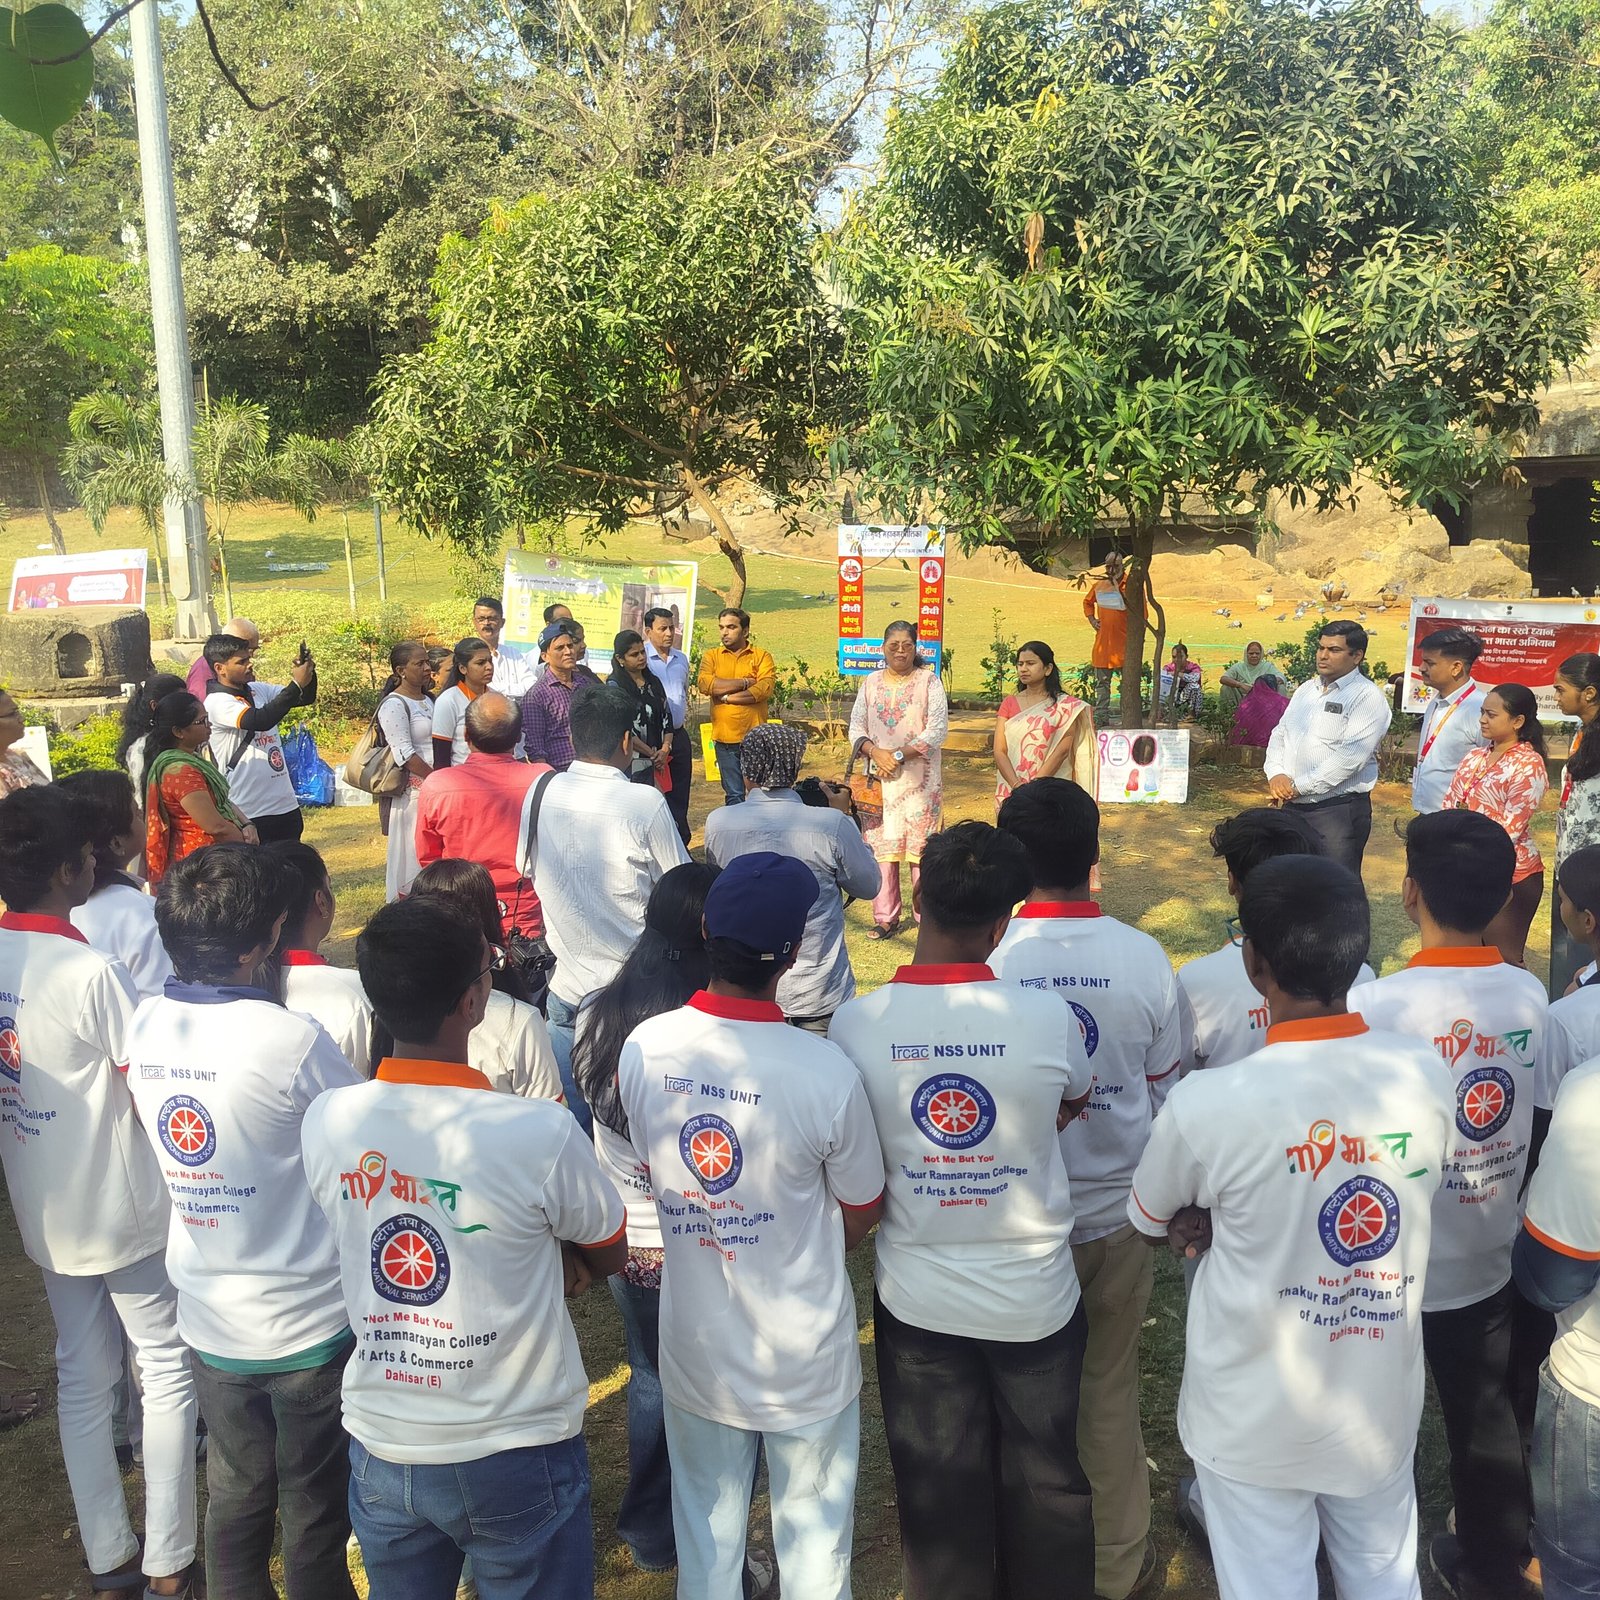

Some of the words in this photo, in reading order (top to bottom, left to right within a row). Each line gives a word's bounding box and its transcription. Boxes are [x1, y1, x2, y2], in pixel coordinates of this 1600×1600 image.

[1053, 976, 1077, 988] NSS
[1080, 976, 1110, 989] UNIT
[934, 1045, 964, 1057] NSS
[967, 1044, 1006, 1057] UNIT
[171, 1068, 191, 1079] NSS
[194, 1070, 217, 1082] UNIT
[701, 1083, 725, 1099] NSS
[730, 1089, 761, 1106] UNIT
[1094, 1084, 1123, 1095] College
[919, 1116, 944, 1141] NATIONAL
[945, 1134, 973, 1145] SERVICE
[972, 1115, 990, 1139] SCHEME
[162, 1133, 183, 1160] NATIONAL
[1470, 1148, 1480, 1156] Me
[1481, 1144, 1494, 1155] But
[1496, 1140, 1511, 1149] You
[923, 1155, 940, 1163] Not
[943, 1155, 956, 1163] Me
[958, 1155, 975, 1163] But
[977, 1154, 994, 1163] You
[1453, 1155, 1505, 1172] Ramnarayan
[166, 1170, 178, 1178] Not
[180, 1171, 190, 1180] Me
[192, 1171, 206, 1180] But
[208, 1172, 224, 1180] You
[929, 1169, 990, 1182] Ramnarayan
[993, 1165, 1028, 1179] College
[171, 1183, 221, 1198] Ramnarayan
[634, 1180, 651, 1193] Arts
[913, 1185, 923, 1195] of
[926, 1186, 946, 1197] Arts
[950, 1186, 957, 1196] &
[959, 1182, 1009, 1196] Commerce
[1446, 1180, 1469, 1190] Arts
[1472, 1180, 1478, 1190] &
[1489, 1186, 1498, 1200] (E)
[195, 1203, 240, 1213] Commerce
[683, 1190, 700, 1199] Not
[710, 1200, 726, 1210] But
[729, 1200, 744, 1211] You
[940, 1198, 973, 1207] Dahisar
[975, 1197, 988, 1207] (E)
[207, 1218, 219, 1229] (E)
[689, 1204, 740, 1229] Ramrayan
[672, 1222, 682, 1235] of
[685, 1223, 706, 1234] Arts
[1324, 1232, 1350, 1261] NATIONAL
[1375, 1225, 1398, 1254] SCHEME
[372, 1267, 400, 1298] NATIONAL
[401, 1291, 429, 1302] SERVICE
[428, 1273, 447, 1299] SCHEME
[1318, 1275, 1340, 1287] Not
[1354, 1268, 1375, 1280] But
[1379, 1271, 1400, 1281] You
[1278, 1285, 1318, 1303] Thakur
[369, 1313, 389, 1324] Not
[393, 1312, 410, 1321] Me
[413, 1313, 430, 1326] But
[432, 1318, 453, 1330] You
[1300, 1309, 1310, 1322] of
[1314, 1313, 1340, 1327] Arts
[1350, 1305, 1404, 1322] Commer
[374, 1329, 445, 1349] Ramnarayan
[450, 1331, 497, 1349] College
[1368, 1327, 1384, 1341] (E)
[369, 1350, 395, 1363] Arts
[400, 1351, 407, 1364] &
[411, 1354, 474, 1370] Commerce
[385, 1368, 424, 1385] Dahisar
[426, 1375, 442, 1389] (E)
